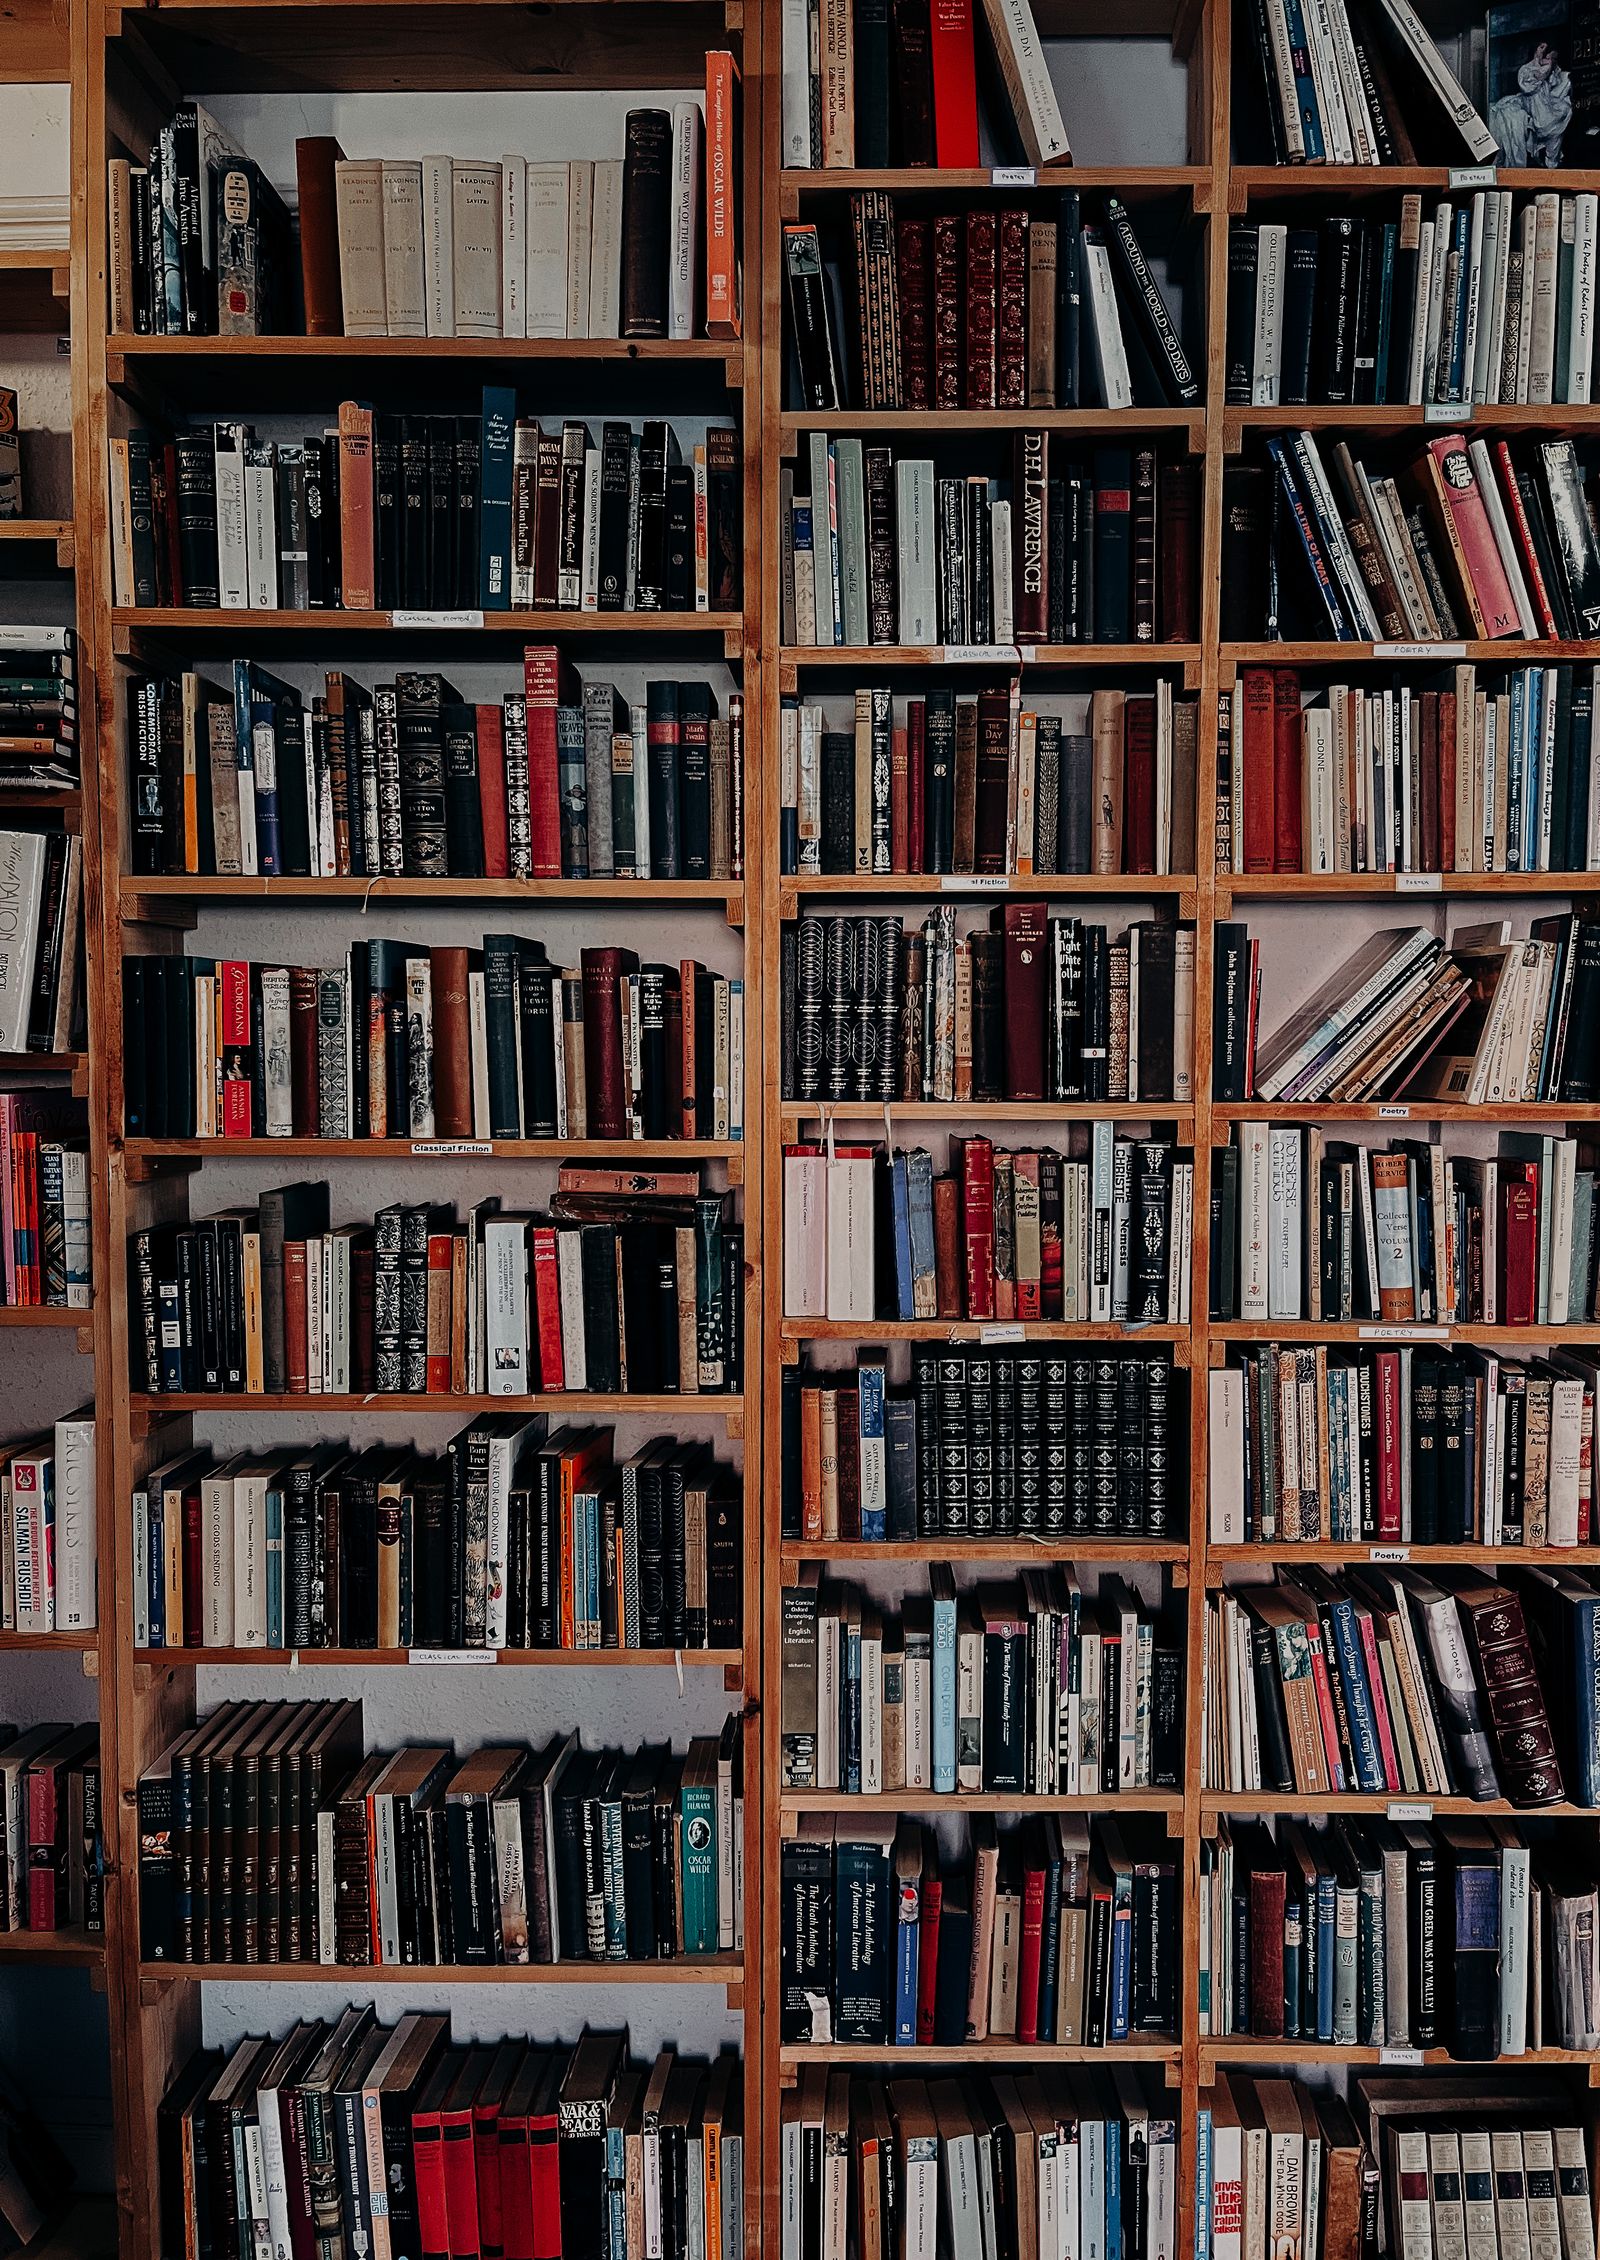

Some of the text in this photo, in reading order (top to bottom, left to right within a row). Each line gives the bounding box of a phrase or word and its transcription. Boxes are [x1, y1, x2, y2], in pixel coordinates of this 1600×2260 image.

[1356, 46, 1388, 137] POEMS OF TO-DAY
[176, 176, 190, 245] Jane Austen
[714, 152, 723, 238] OSCAR WILDE
[680, 191, 690, 280] WAY OF THE WORLD
[1120, 226, 1145, 275] AROUND
[1144, 285, 1166, 327] WORLD
[1165, 335, 1176, 349] 80
[1171, 352, 1188, 380] DAYS
[1267, 232, 1277, 317] COLLECTED POEMS
[518, 468, 529, 560] The Mill on the Floss
[1025, 434, 1046, 593] D.H. LAWRENCE
[1294, 502, 1329, 586] IN TIME OF WAR
[138, 690, 148, 761] IRISH FICTION
[146, 682, 156, 767] CONTEMPORARY
[1317, 738, 1325, 772] DONNE
[230, 968, 245, 1036] GEORGIANA
[1226, 950, 1237, 1065] John Betjeman collected poems
[1382, 1107, 1406, 1115] Poetry
[415, 1144, 458, 1152] Classical
[1099, 1126, 1109, 1205] AGATHA CHRISTIE
[1115, 1150, 1125, 1203] CHRISTIE
[1272, 1141, 1284, 1202] OMNIBUS
[1285, 1135, 1297, 1208] NONSENSE
[1376, 1160, 1407, 1168] ROBERT
[1119, 1218, 1129, 1266] Nemesis
[1394, 1248, 1403, 1259] 2
[312, 1306, 318, 1314] OF
[1360, 1365, 1370, 1429] TOUCHSTONES
[469, 1445, 486, 1453] Born
[470, 1455, 485, 1463] Free
[1511, 1438, 1518, 1446] OF
[66, 1429, 81, 1548] ERIC SYKES
[15, 1507, 32, 1612] SALMAN RUSHDIE
[30, 1521, 38, 1549] GROUND
[31, 1550, 39, 1580] BENEATH
[1375, 1552, 1403, 1561] Poetry
[32, 1581, 40, 1595] HER
[32, 1597, 40, 1612] FEET
[1441, 1605, 1462, 1680] DYLAN THOMAS
[1002, 1701, 1010, 1720] Hardy
[85, 1774, 95, 1829] TREATMENT
[90, 1883, 98, 1912] TAYLOR
[583, 1802, 594, 1892] voices on the green
[611, 1809, 624, 1921] AN EVERYMAN ANTHOLOGY
[688, 1856, 711, 1864] OSCAR
[689, 1865, 710, 1873] WILDE
[794, 1884, 805, 1973] of American Literature
[806, 1884, 819, 1967] The Heath Anthology
[850, 1882, 861, 1970] of American Literature
[862, 1883, 875, 1965] The Heath Anthology
[1424, 1885, 1434, 2008] HOW GREEN WAS MY VALLEY
[346, 2112, 354, 2135] TRACES
[348, 2136, 355, 2144] OF
[560, 2105, 600, 2118] WAR &
[560, 2118, 600, 2131] PEACE
[349, 2146, 357, 2171] THOMAS
[368, 2115, 382, 2188] ALLAN MASSIE
[350, 2172, 359, 2195] HARIOT
[1214, 2180, 1240, 2192] invis
[1215, 2204, 1242, 2215] man
[1216, 2191, 1240, 2204] ible
[1276, 2149, 1284, 2234] THE DA VINCI CODE
[1286, 2157, 1298, 2229] DAN BROWN
[1214, 2225, 1241, 2234] ellison
[1215, 2215, 1240, 2226] ralph
